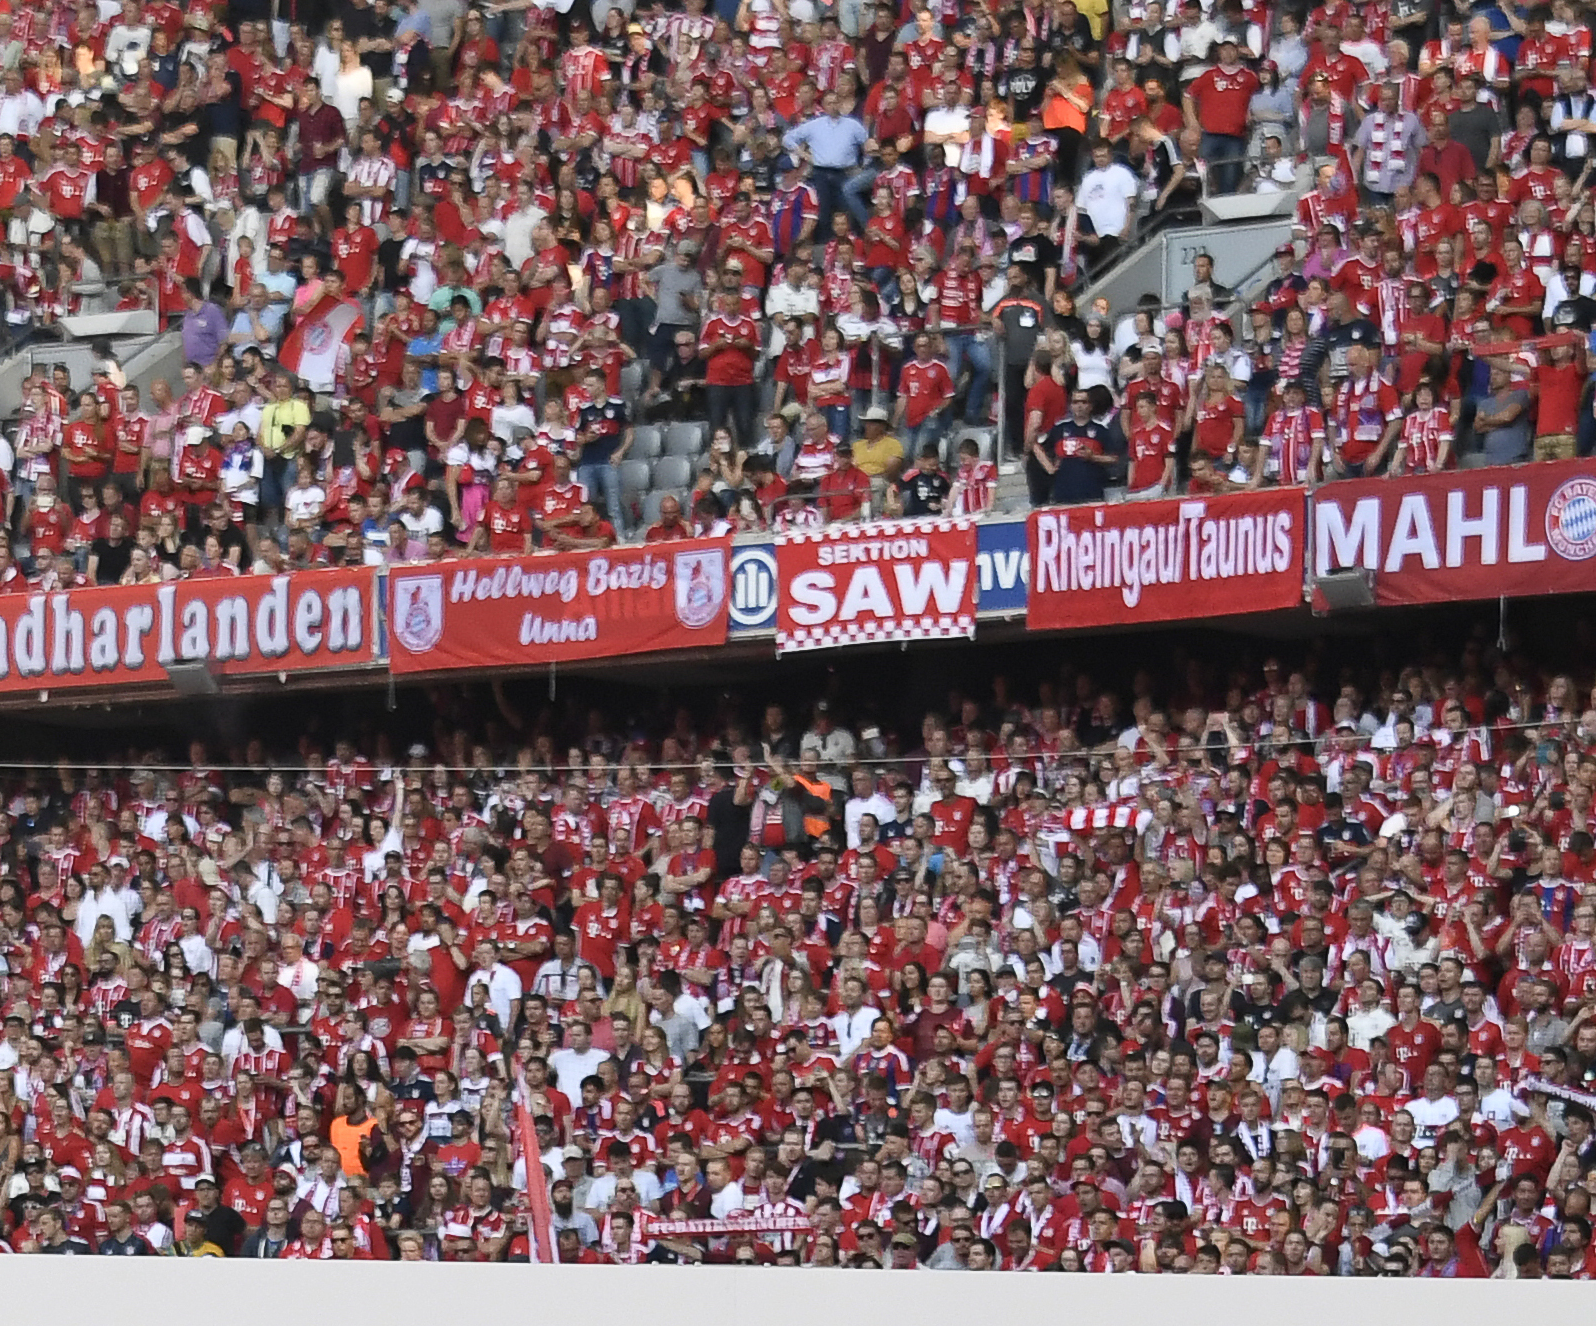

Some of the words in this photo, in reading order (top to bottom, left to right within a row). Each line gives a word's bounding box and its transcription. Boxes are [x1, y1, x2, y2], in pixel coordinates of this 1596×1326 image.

[817, 538, 929, 567] SEKTION
[1036, 501, 1293, 608] Rheingau/Taunus
[451, 564, 579, 604] Hellweg
[586, 554, 669, 597] Bazis
[787, 559, 970, 626] SAW
[519, 612, 598, 646] Unna
